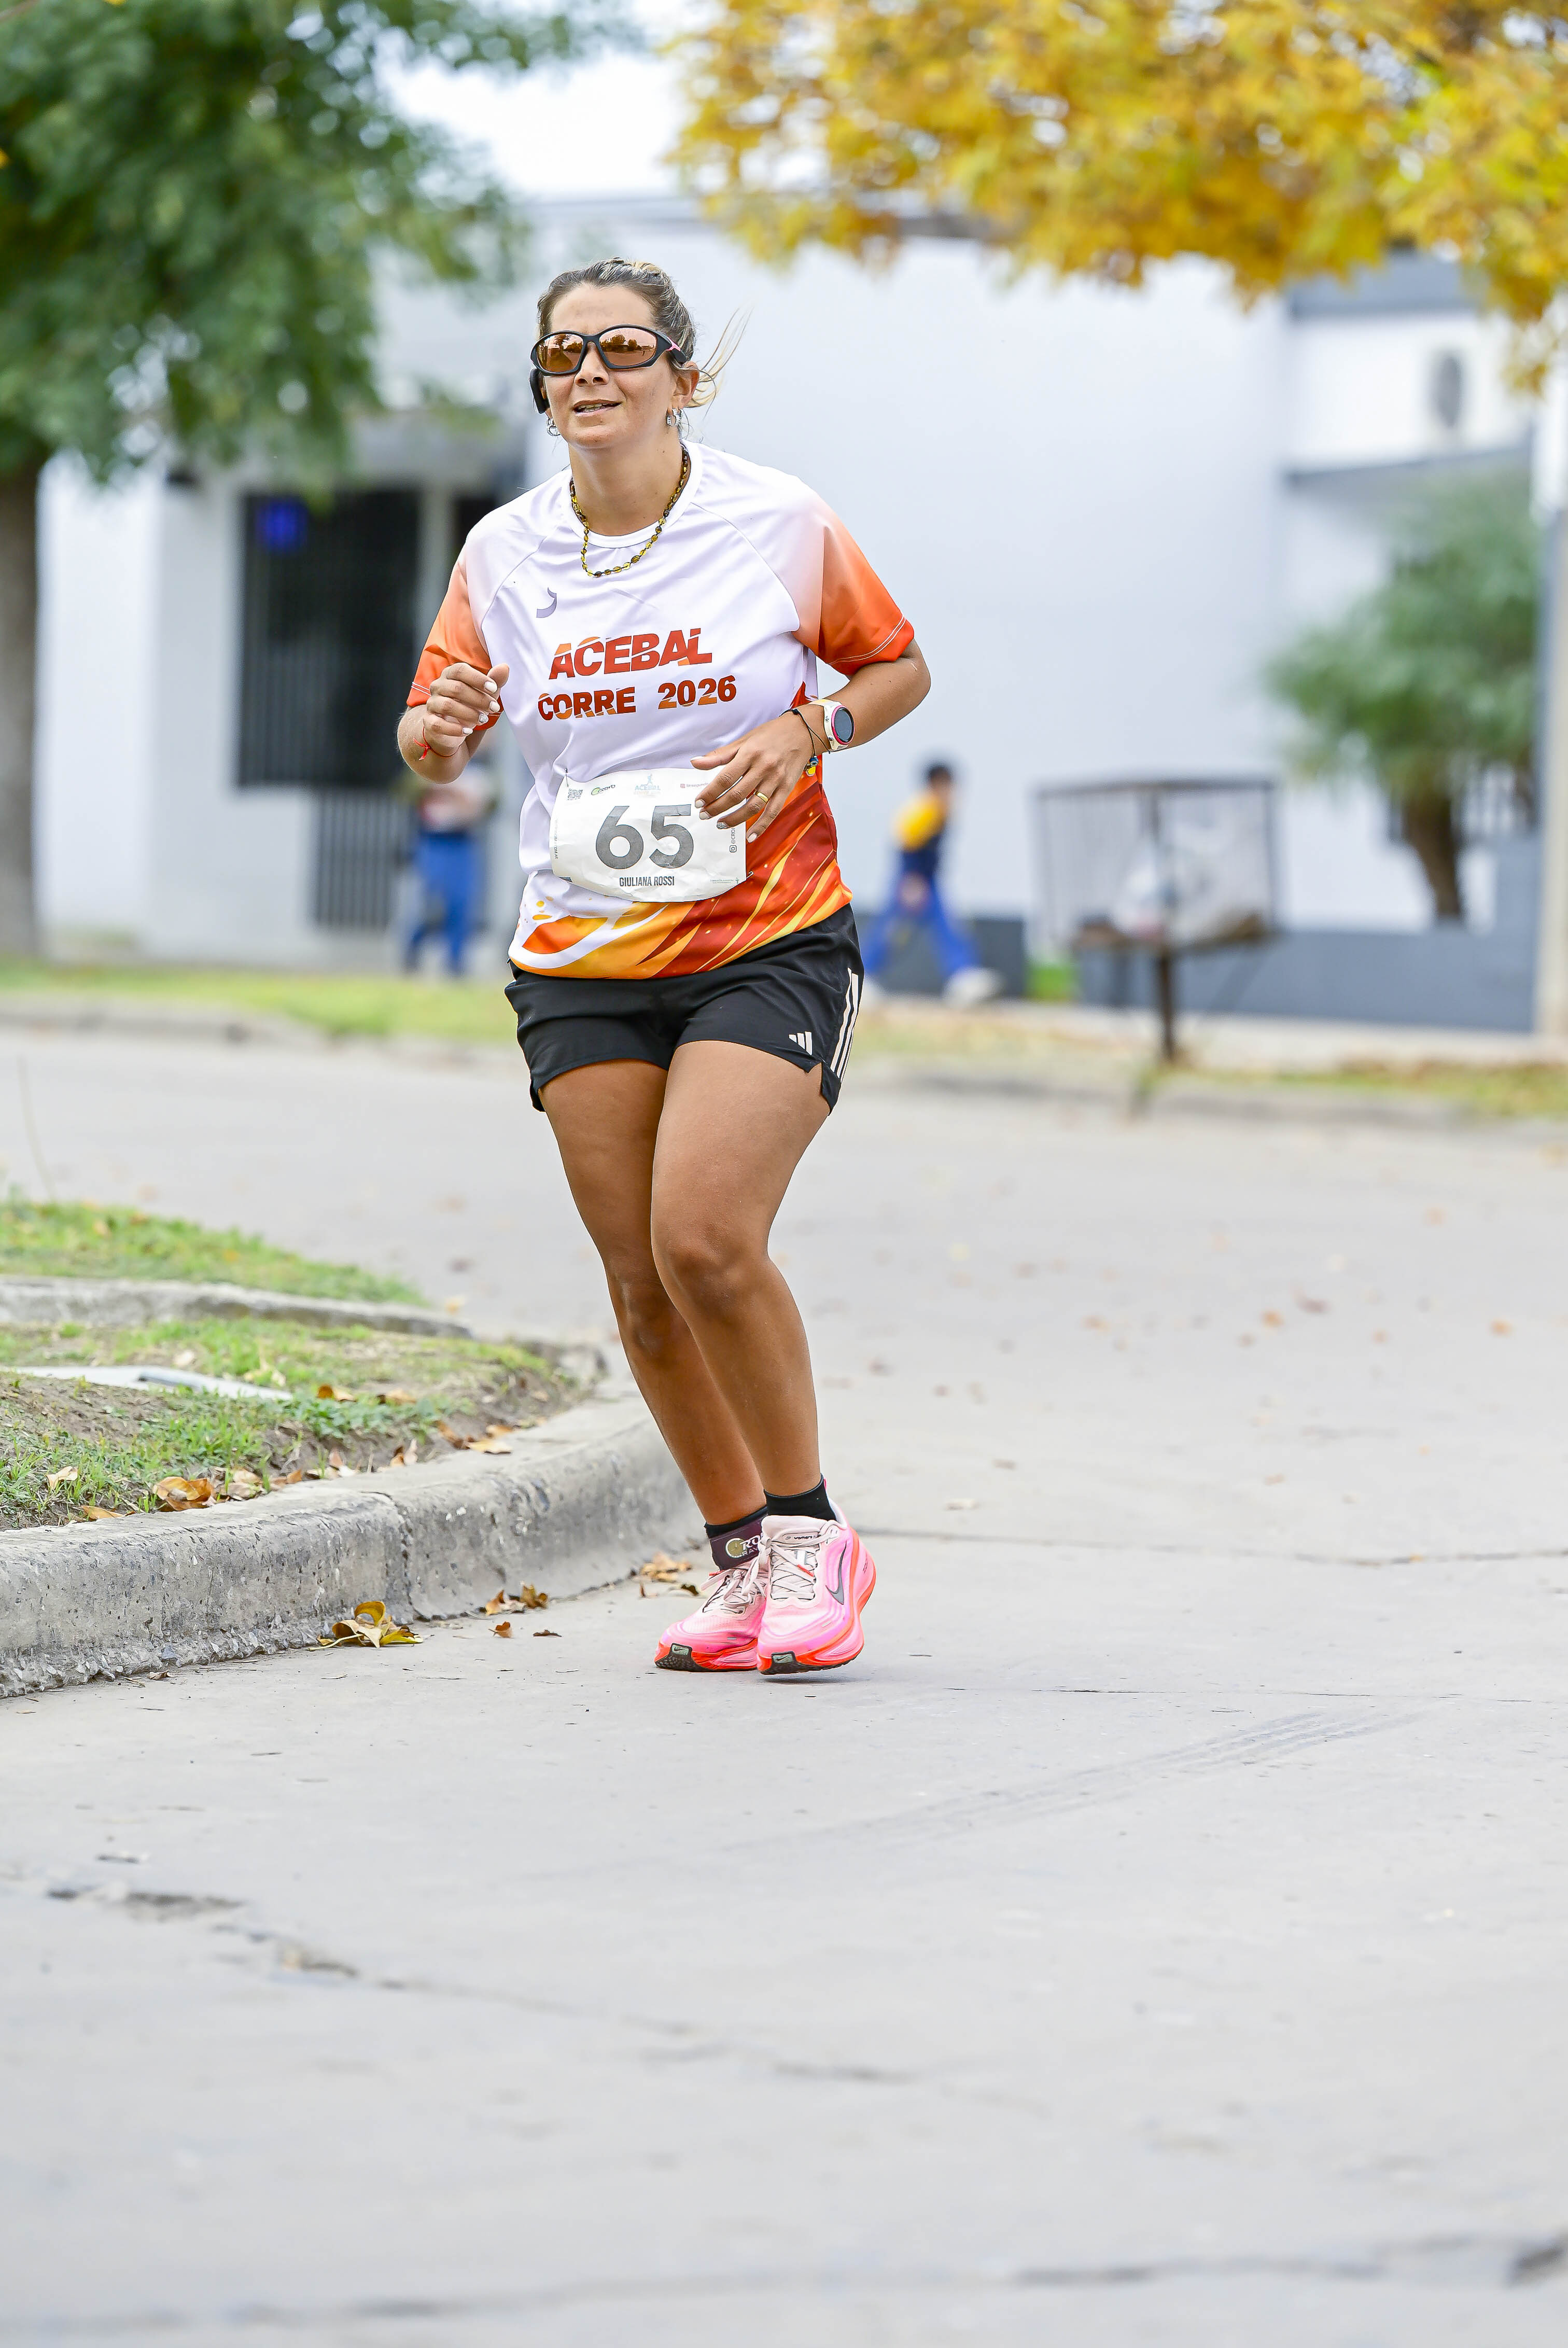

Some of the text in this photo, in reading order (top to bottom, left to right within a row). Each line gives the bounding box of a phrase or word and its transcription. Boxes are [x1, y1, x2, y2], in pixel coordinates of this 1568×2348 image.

[549, 628, 712, 679] ACEBAL
[538, 675, 736, 721] CORRE 2026
[596, 804, 694, 869] 65
[620, 876, 674, 886] GIULIANA ROSSI
